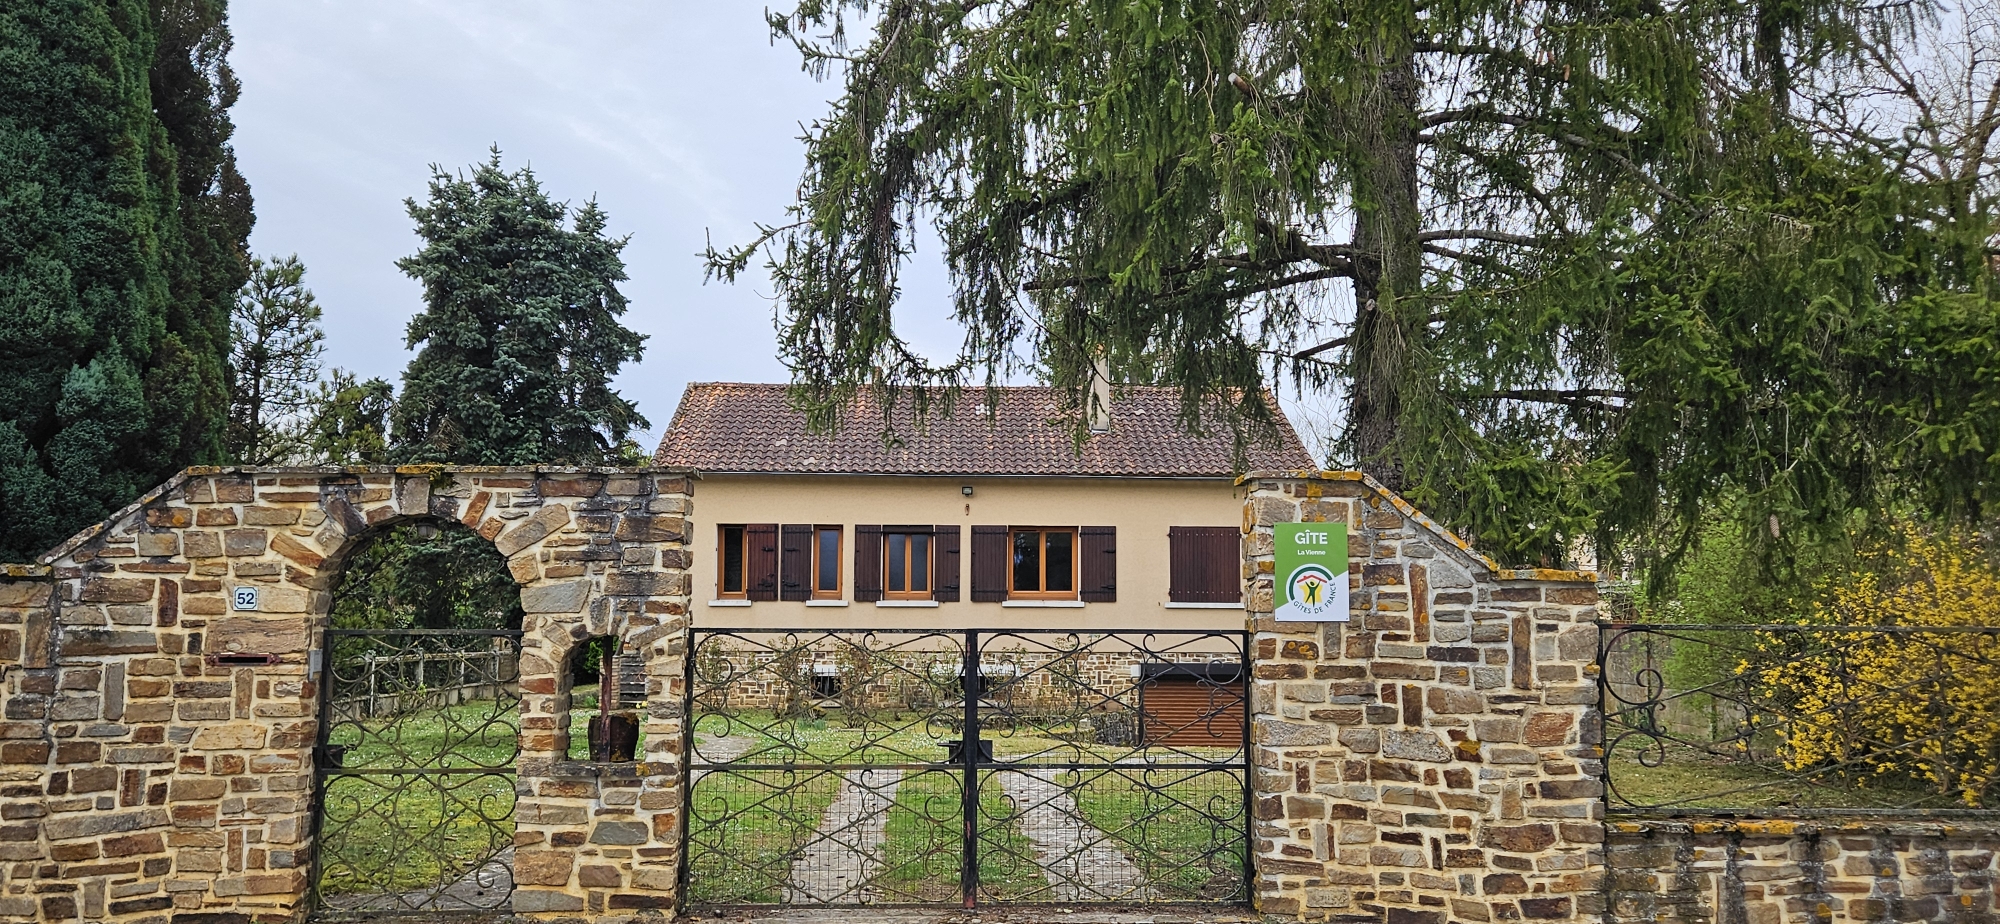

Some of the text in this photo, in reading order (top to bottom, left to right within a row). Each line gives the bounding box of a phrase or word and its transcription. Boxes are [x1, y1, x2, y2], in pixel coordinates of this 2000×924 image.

[1294, 529, 1328, 545] GÎTE
[237, 592, 255, 605] 52
[1293, 581, 1336, 614] GÎTES DE FRANCE
